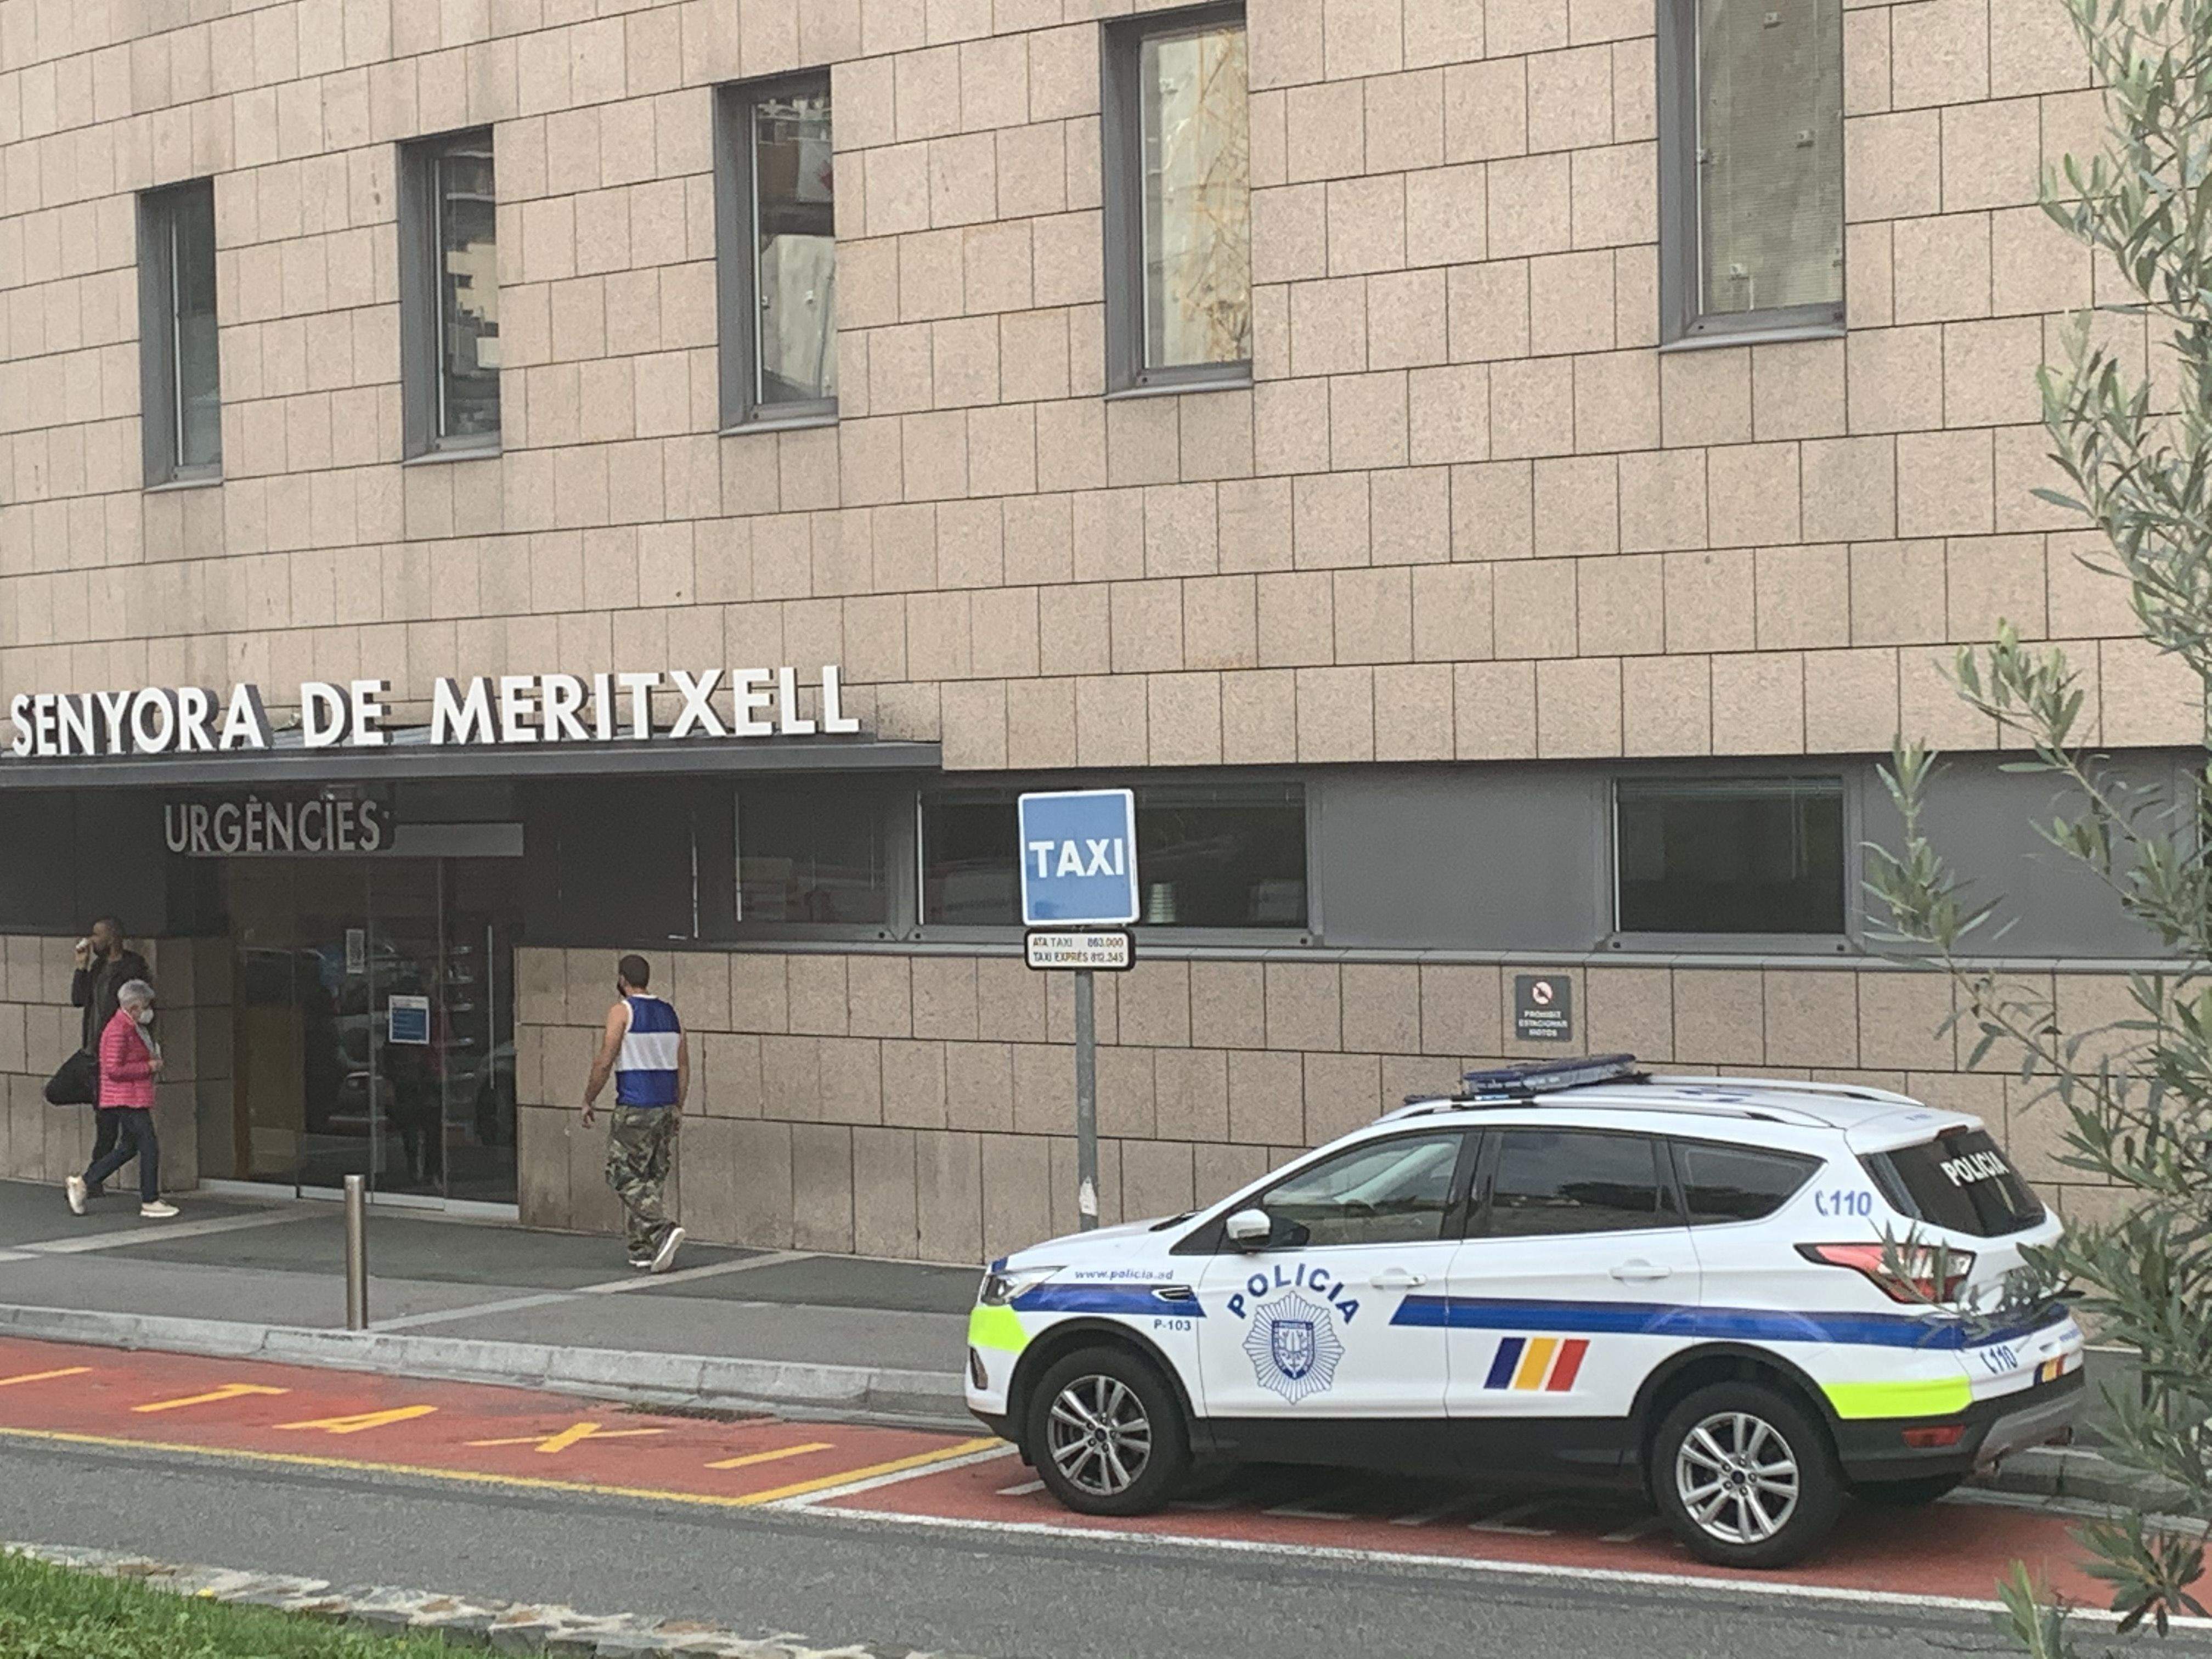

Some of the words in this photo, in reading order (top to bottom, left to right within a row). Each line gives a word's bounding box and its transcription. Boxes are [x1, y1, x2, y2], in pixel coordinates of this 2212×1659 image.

[11, 682, 269, 756] SENYORA
[301, 680, 388, 747] DE
[431, 665, 860, 744] MERITXELL
[165, 794, 381, 854] URGÈNCIES
[1028, 838, 1125, 878] TAXI
[1033, 937, 1048, 947] ATA
[1051, 938, 1073, 947] TAXI
[1087, 938, 1124, 947] 863.000
[1033, 952, 1052, 962] TAXI
[1939, 1150, 2010, 1187] POLICIA
[1830, 1190, 1872, 1216] 110
[1074, 1268, 1174, 1280] www.policia.ad
[1227, 1263, 1360, 1325] POLICIA
[1154, 1319, 1192, 1331] P-103
[1990, 1345, 2018, 1372] 110
